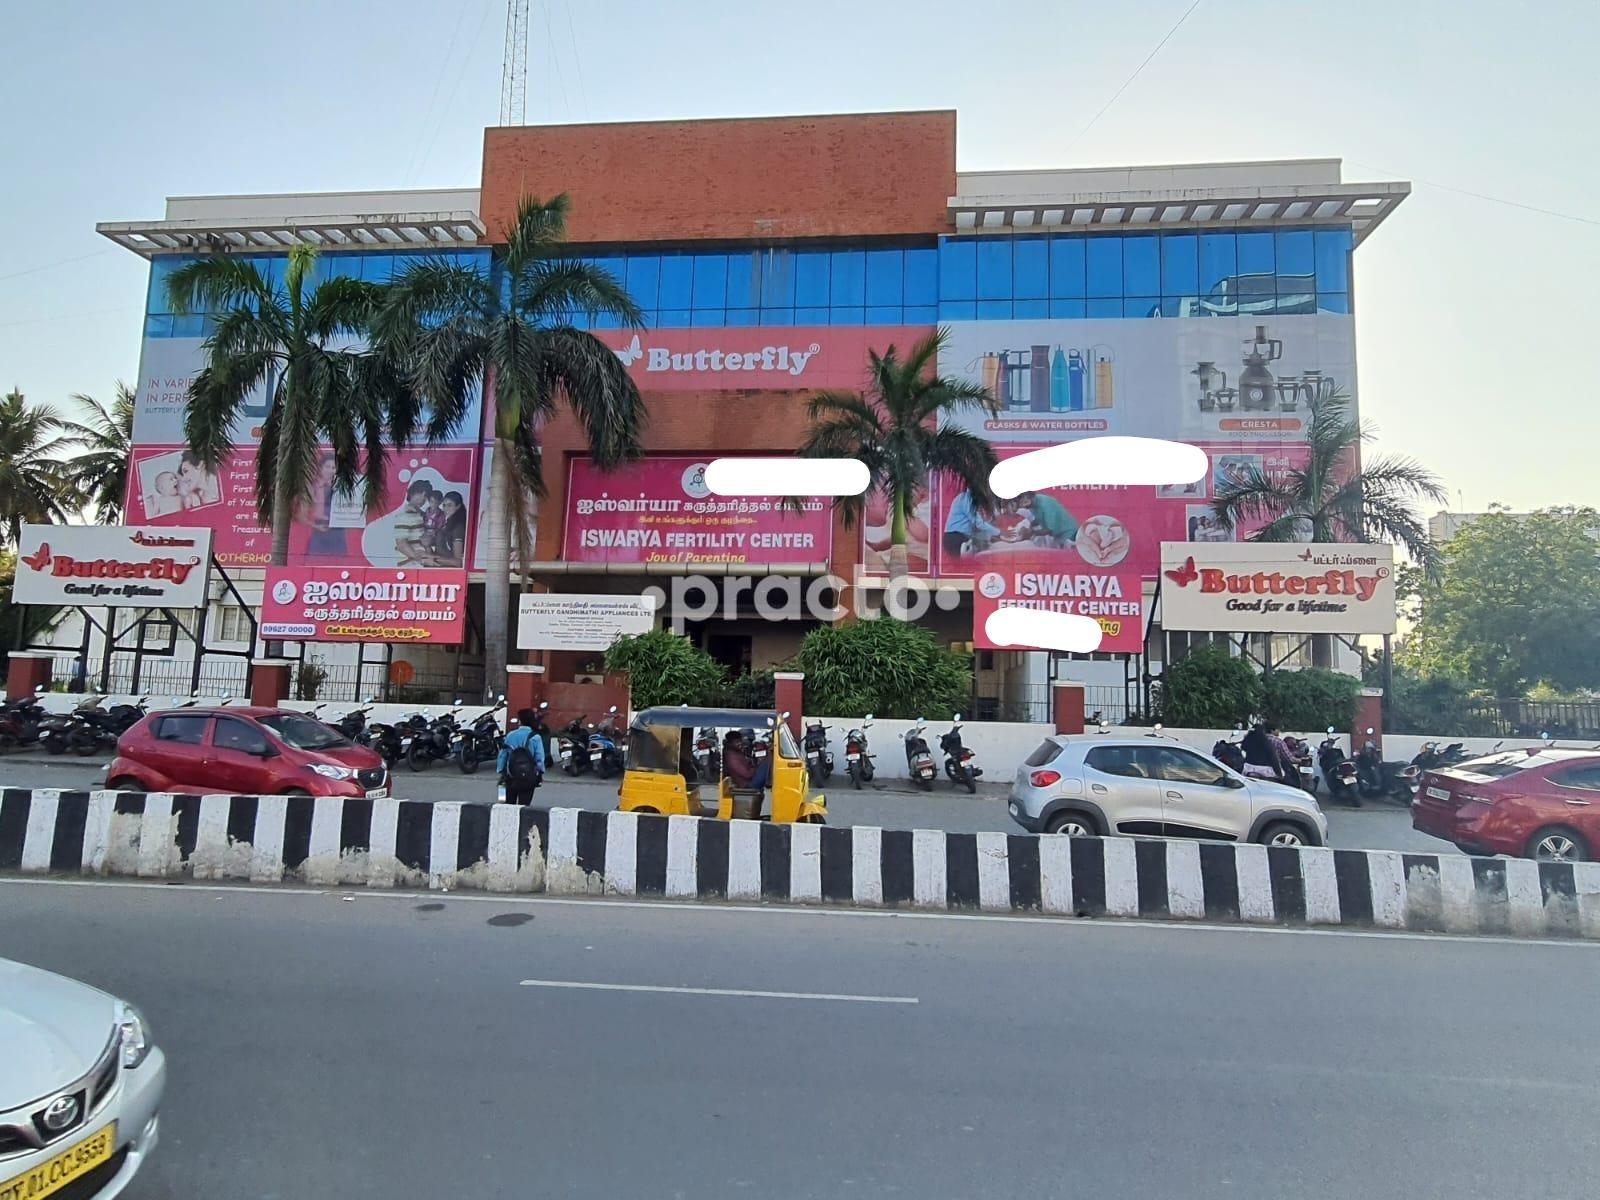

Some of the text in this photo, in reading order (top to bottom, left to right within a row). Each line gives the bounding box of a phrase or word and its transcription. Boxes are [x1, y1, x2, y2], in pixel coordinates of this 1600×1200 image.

[148, 378, 194, 389] IN VARIE
[146, 393, 187, 403] IN PERF
[986, 422, 1020, 430] FLASKS
[1030, 421, 1062, 429] WATER
[1064, 421, 1104, 429] BOTTLES
[1241, 420, 1278, 428] CRESTA
[232, 459, 252, 467] First
[230, 472, 249, 480] First
[233, 485, 252, 493] First
[576, 492, 681, 514] ஐஸ்வர்யா
[580, 530, 814, 548] ISWARYA FERTILITY CENTER
[670, 552, 682, 562] of
[64, 584, 95, 595] Good
[303, 571, 461, 604] ஐஸ்வர்யா
[1014, 573, 1122, 598] ISWARYA
[1078, 601, 1139, 616] CENTER
[1226, 599, 1347, 615] Good for a lifetime
[303, 604, 456, 622] கருத்தரித்தல் மையம்
